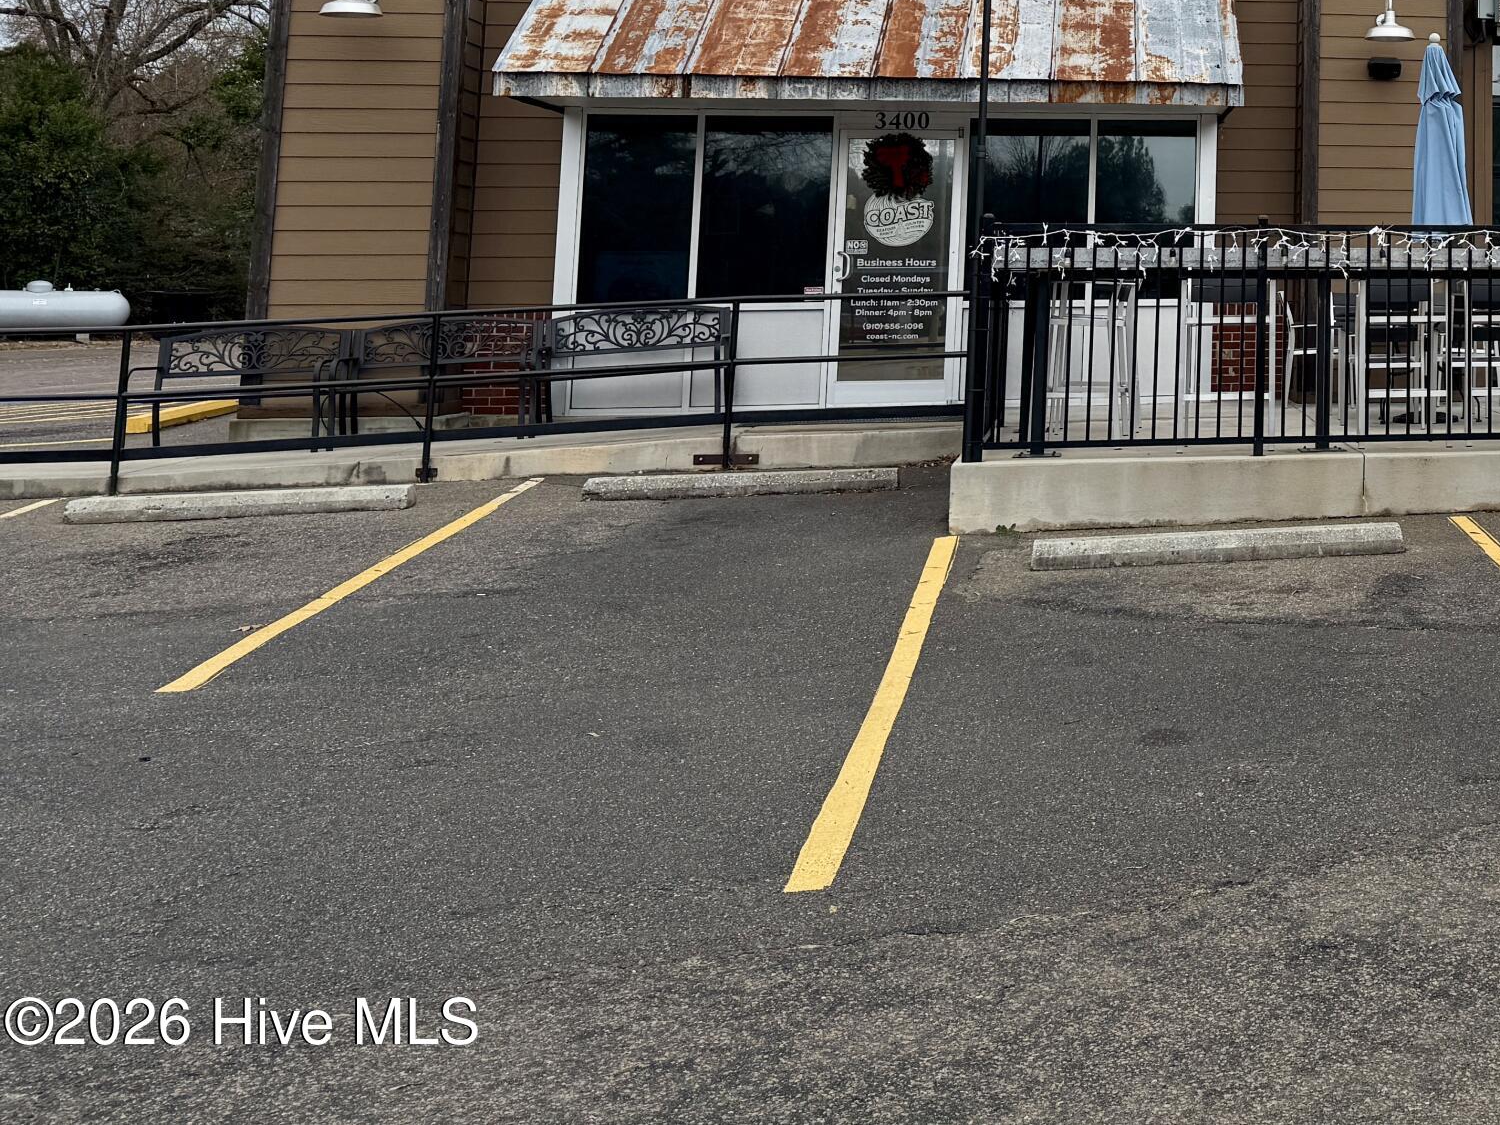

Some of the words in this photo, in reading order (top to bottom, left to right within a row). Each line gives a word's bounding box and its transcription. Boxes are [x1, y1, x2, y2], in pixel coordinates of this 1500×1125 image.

[875, 112, 930, 130] 3400
[866, 201, 934, 227] COAST
[847, 241, 860, 249] NO
[856, 258, 903, 267] Business
[905, 258, 937, 267] Hours
[861, 275, 890, 283] Closed
[892, 275, 931, 284] Mondays
[906, 299, 938, 307] 2:30pm
[887, 309, 907, 317] 4pm
[913, 309, 933, 317] 8pm
